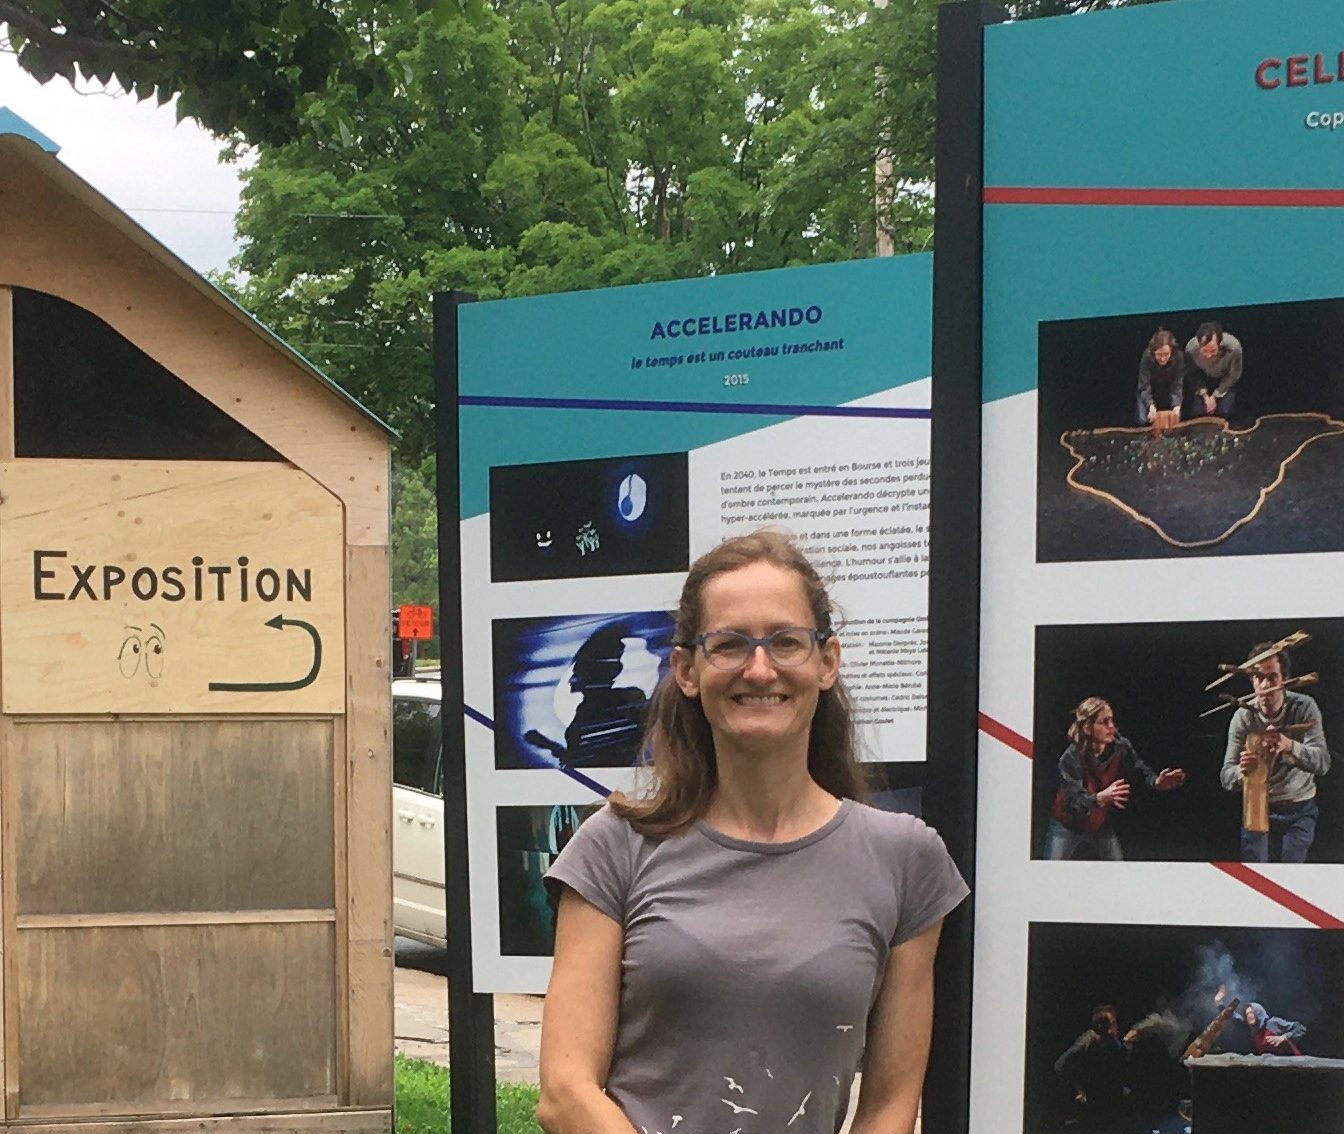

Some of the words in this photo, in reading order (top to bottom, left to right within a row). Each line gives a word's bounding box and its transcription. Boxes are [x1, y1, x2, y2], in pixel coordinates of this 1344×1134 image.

[650, 305, 822, 340] ACCELERANDO
[631, 357, 643, 370] le
[646, 355, 684, 368] temps
[686, 351, 706, 364] est
[709, 351, 725, 362] un
[728, 346, 779, 360] couteau
[782, 338, 844, 355] tranchant
[724, 372, 750, 386] 2015
